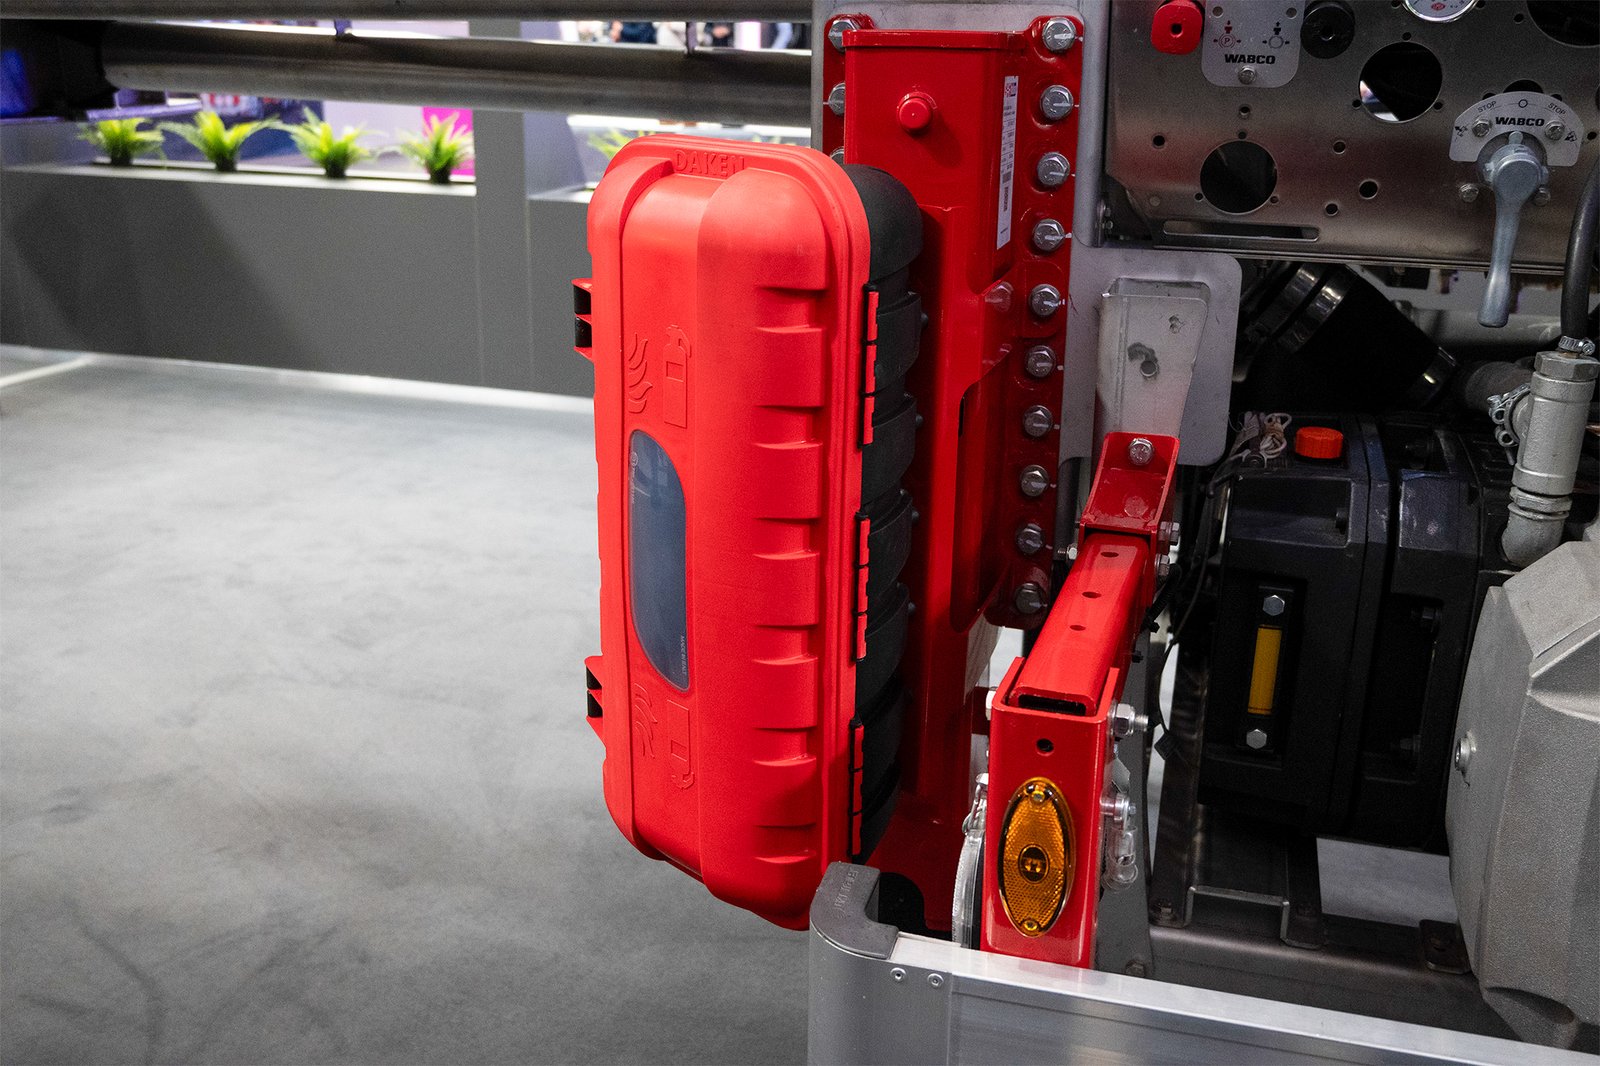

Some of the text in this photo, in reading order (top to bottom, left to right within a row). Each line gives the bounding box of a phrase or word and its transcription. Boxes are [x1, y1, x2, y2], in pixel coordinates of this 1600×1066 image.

[1224, 37, 1231, 45] P
[1224, 54, 1276, 65] WABCO
[1477, 100, 1567, 116] STOP STOP
[1495, 116, 1545, 127] WABCO
[674, 149, 745, 177] DAKEN
